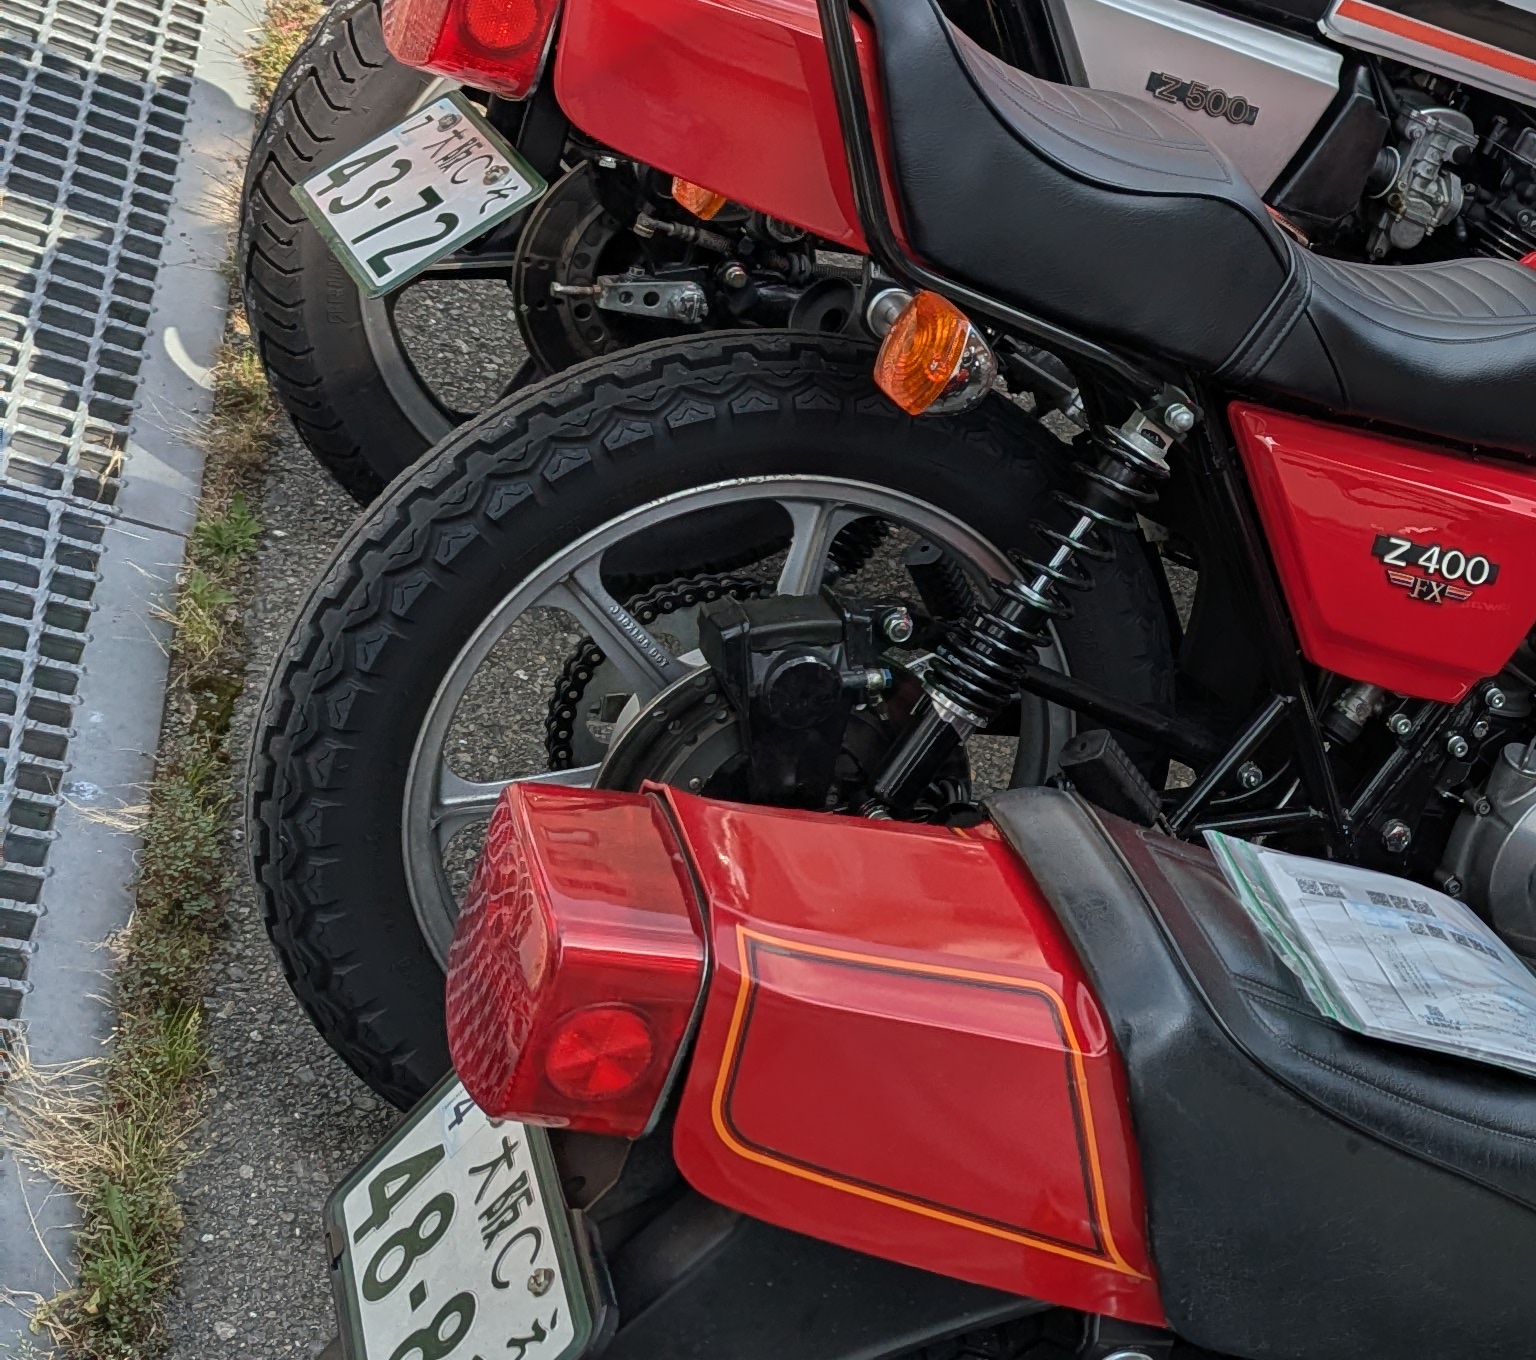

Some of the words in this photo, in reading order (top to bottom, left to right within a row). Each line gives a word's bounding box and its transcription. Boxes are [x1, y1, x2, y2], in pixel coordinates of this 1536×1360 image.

[1154, 72, 1182, 104] Z
[1183, 80, 1250, 124] 500
[422, 128, 494, 185] 大阪C
[316, 144, 460, 278] 43-72
[1383, 537, 1412, 567] Z
[1418, 546, 1490, 585] 400
[1409, 577, 1446, 604] FX
[469, 1135, 543, 1290] 大阪C
